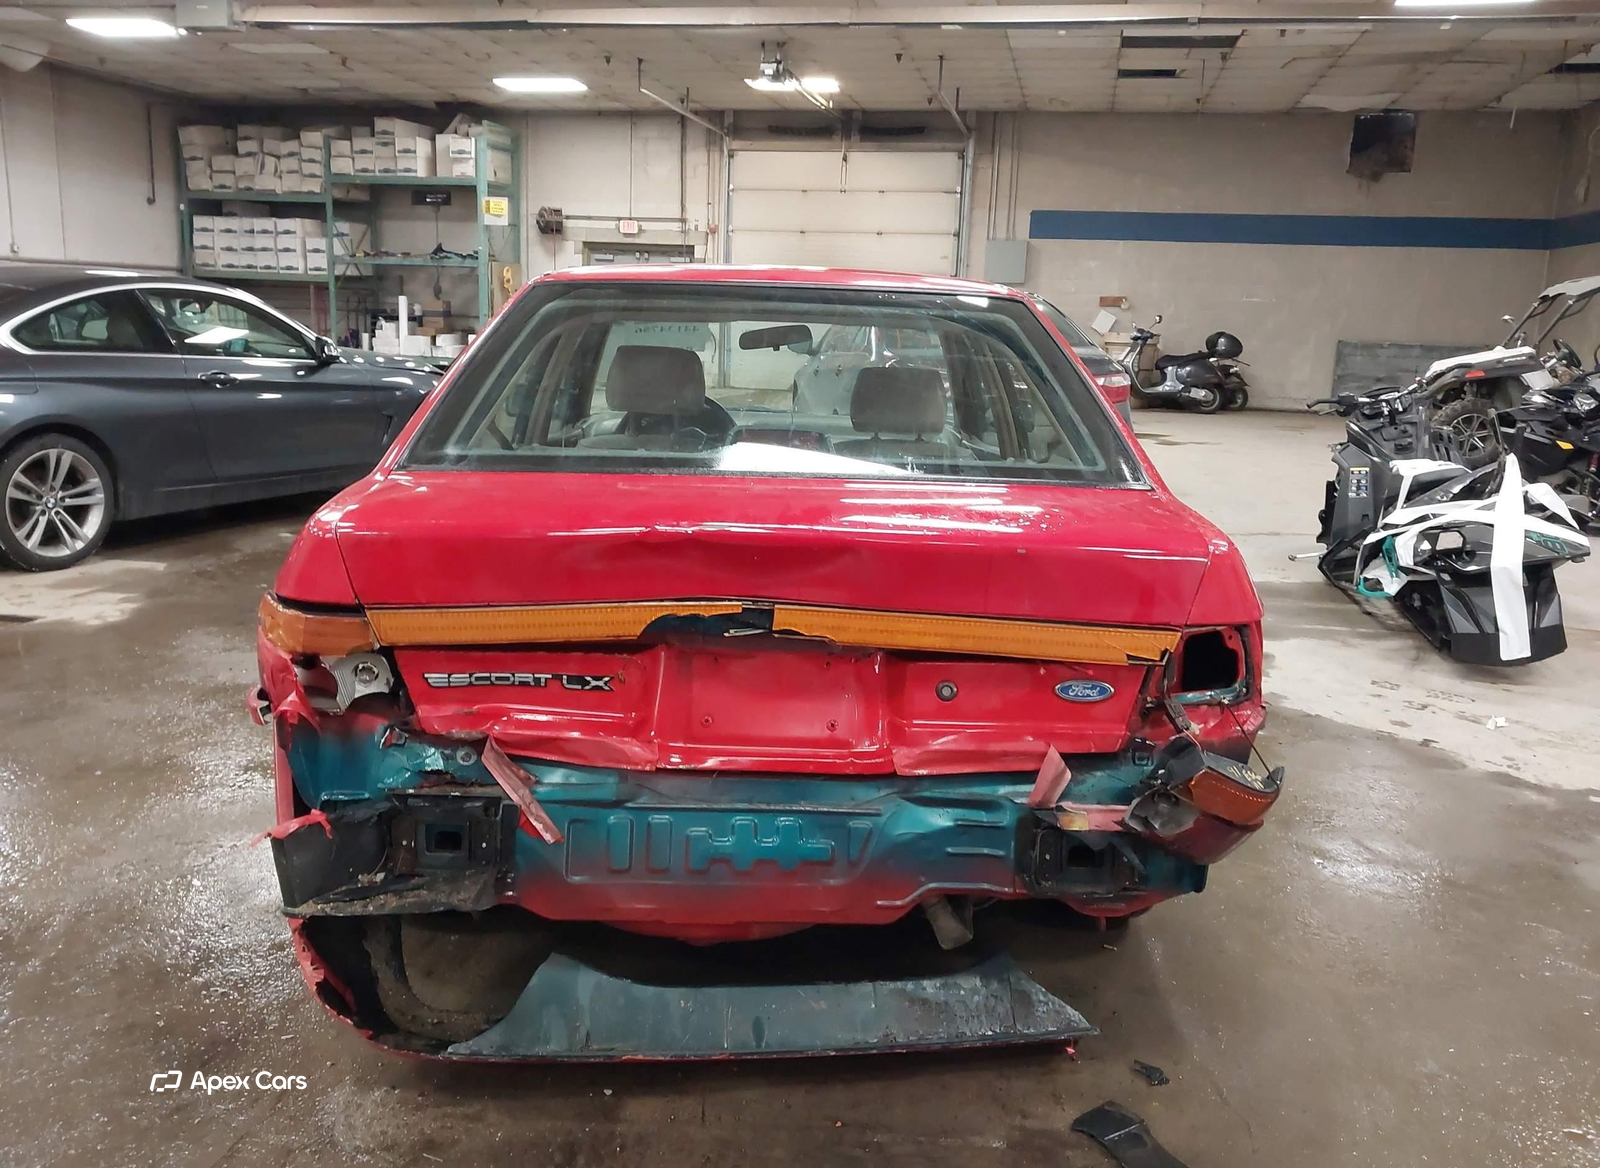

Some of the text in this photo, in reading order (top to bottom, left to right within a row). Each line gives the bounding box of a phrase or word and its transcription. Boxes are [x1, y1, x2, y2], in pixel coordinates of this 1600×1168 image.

[622, 221, 635, 232] EXIT
[424, 672, 613, 691] ESCORT LX
[1068, 684, 1100, 697] Ford
